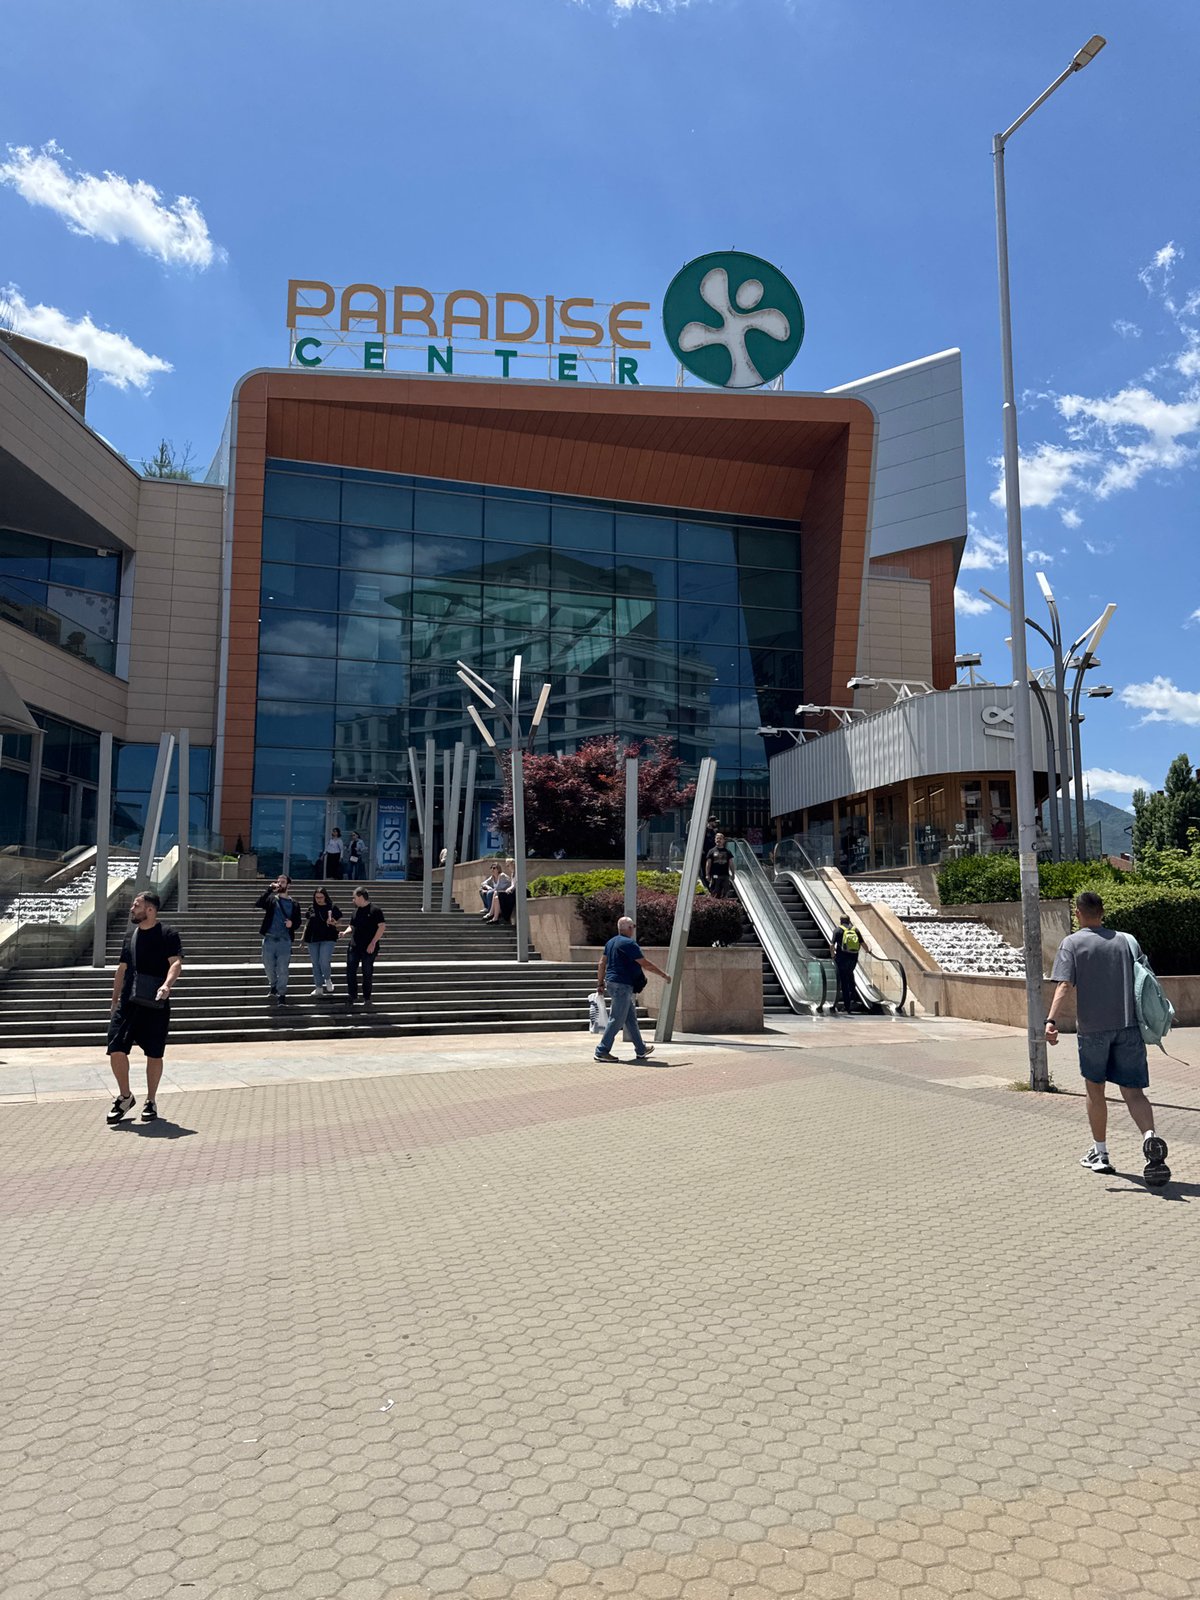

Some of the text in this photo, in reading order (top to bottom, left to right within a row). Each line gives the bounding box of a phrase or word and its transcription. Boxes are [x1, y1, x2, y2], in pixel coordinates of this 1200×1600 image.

[286, 279, 651, 349] PARADISE
[295, 337, 640, 385] CENTER
[383, 818, 401, 864] ESSE
[947, 833, 974, 842] LATE
